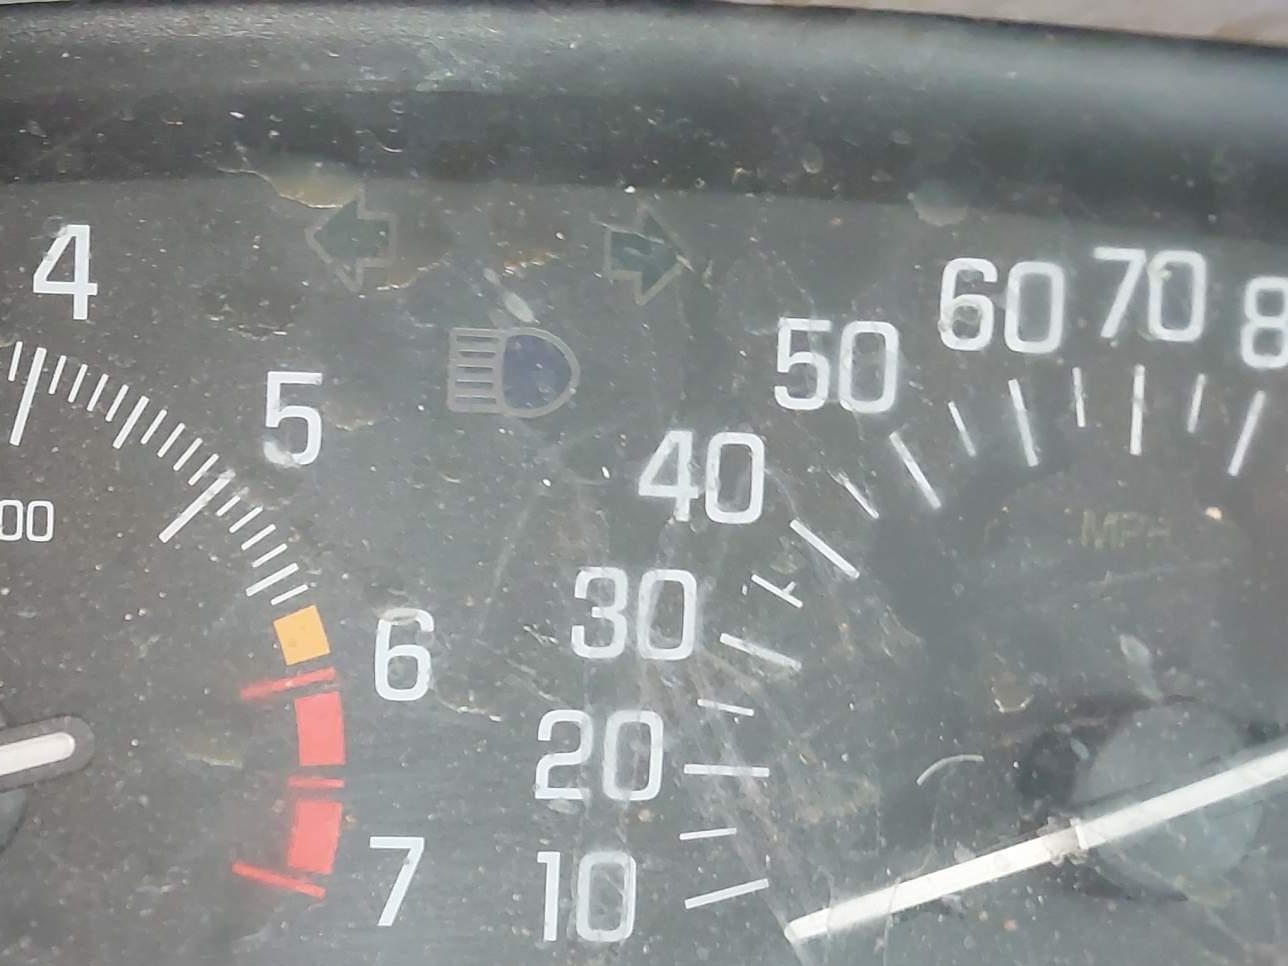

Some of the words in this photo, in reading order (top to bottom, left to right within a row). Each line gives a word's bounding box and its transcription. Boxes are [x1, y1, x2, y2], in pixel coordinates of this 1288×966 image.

[33, 224, 98, 320] 4
[939, 257, 1066, 354] 60
[1094, 246, 1206, 342] 70
[774, 318, 900, 414] 50
[263, 371, 324, 467] 5
[638, 430, 766, 524] 40
[374, 608, 435, 702] 6
[570, 566, 698, 661] 30
[534, 708, 665, 801] 20
[369, 836, 426, 928] 7
[536, 850, 638, 943] 10
